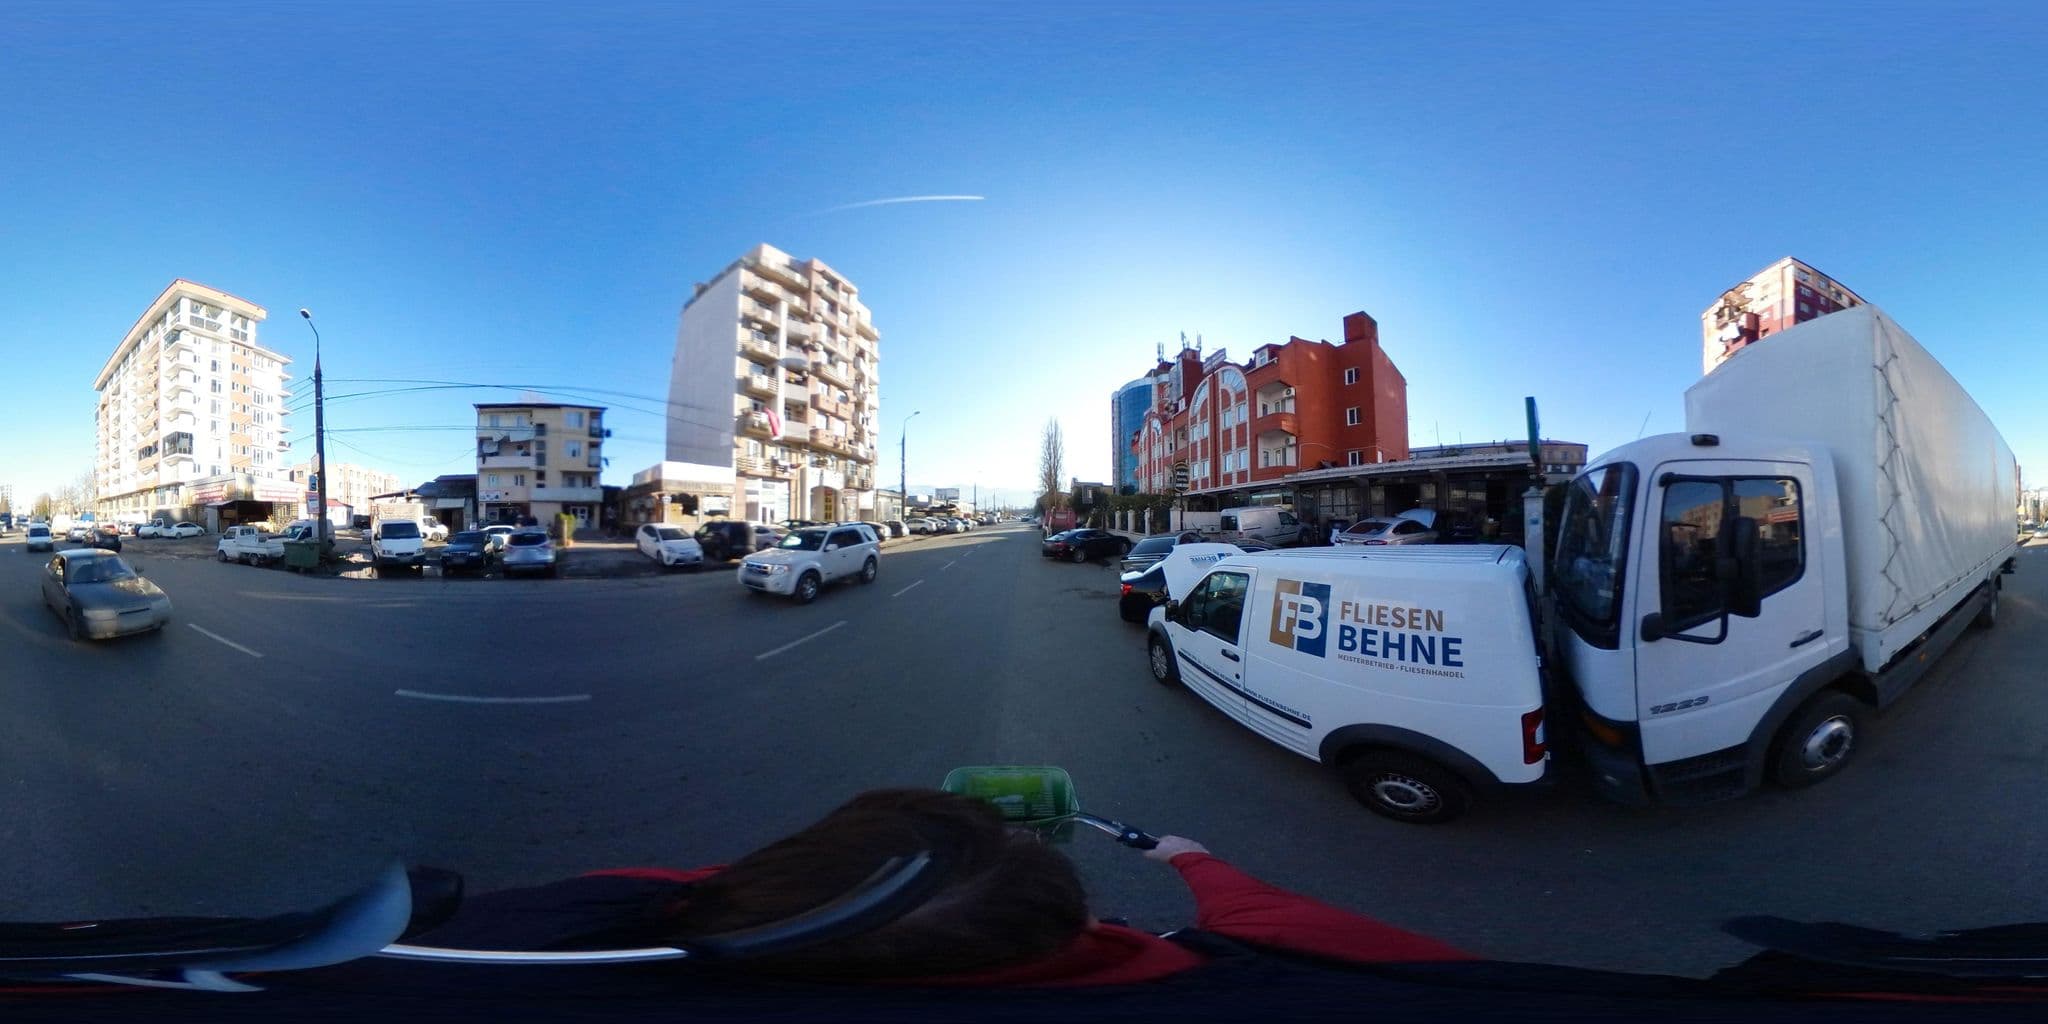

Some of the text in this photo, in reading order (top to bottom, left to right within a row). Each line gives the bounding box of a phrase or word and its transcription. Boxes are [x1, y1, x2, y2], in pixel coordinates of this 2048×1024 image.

[1340, 601, 1443, 632] FLIESEN
[1338, 624, 1464, 668] BEHNE
[1337, 653, 1395, 670] MEISTERBETRIEB
[1400, 665, 1464, 679] FLIESENHANDEL
[1649, 695, 1709, 715] 1223
